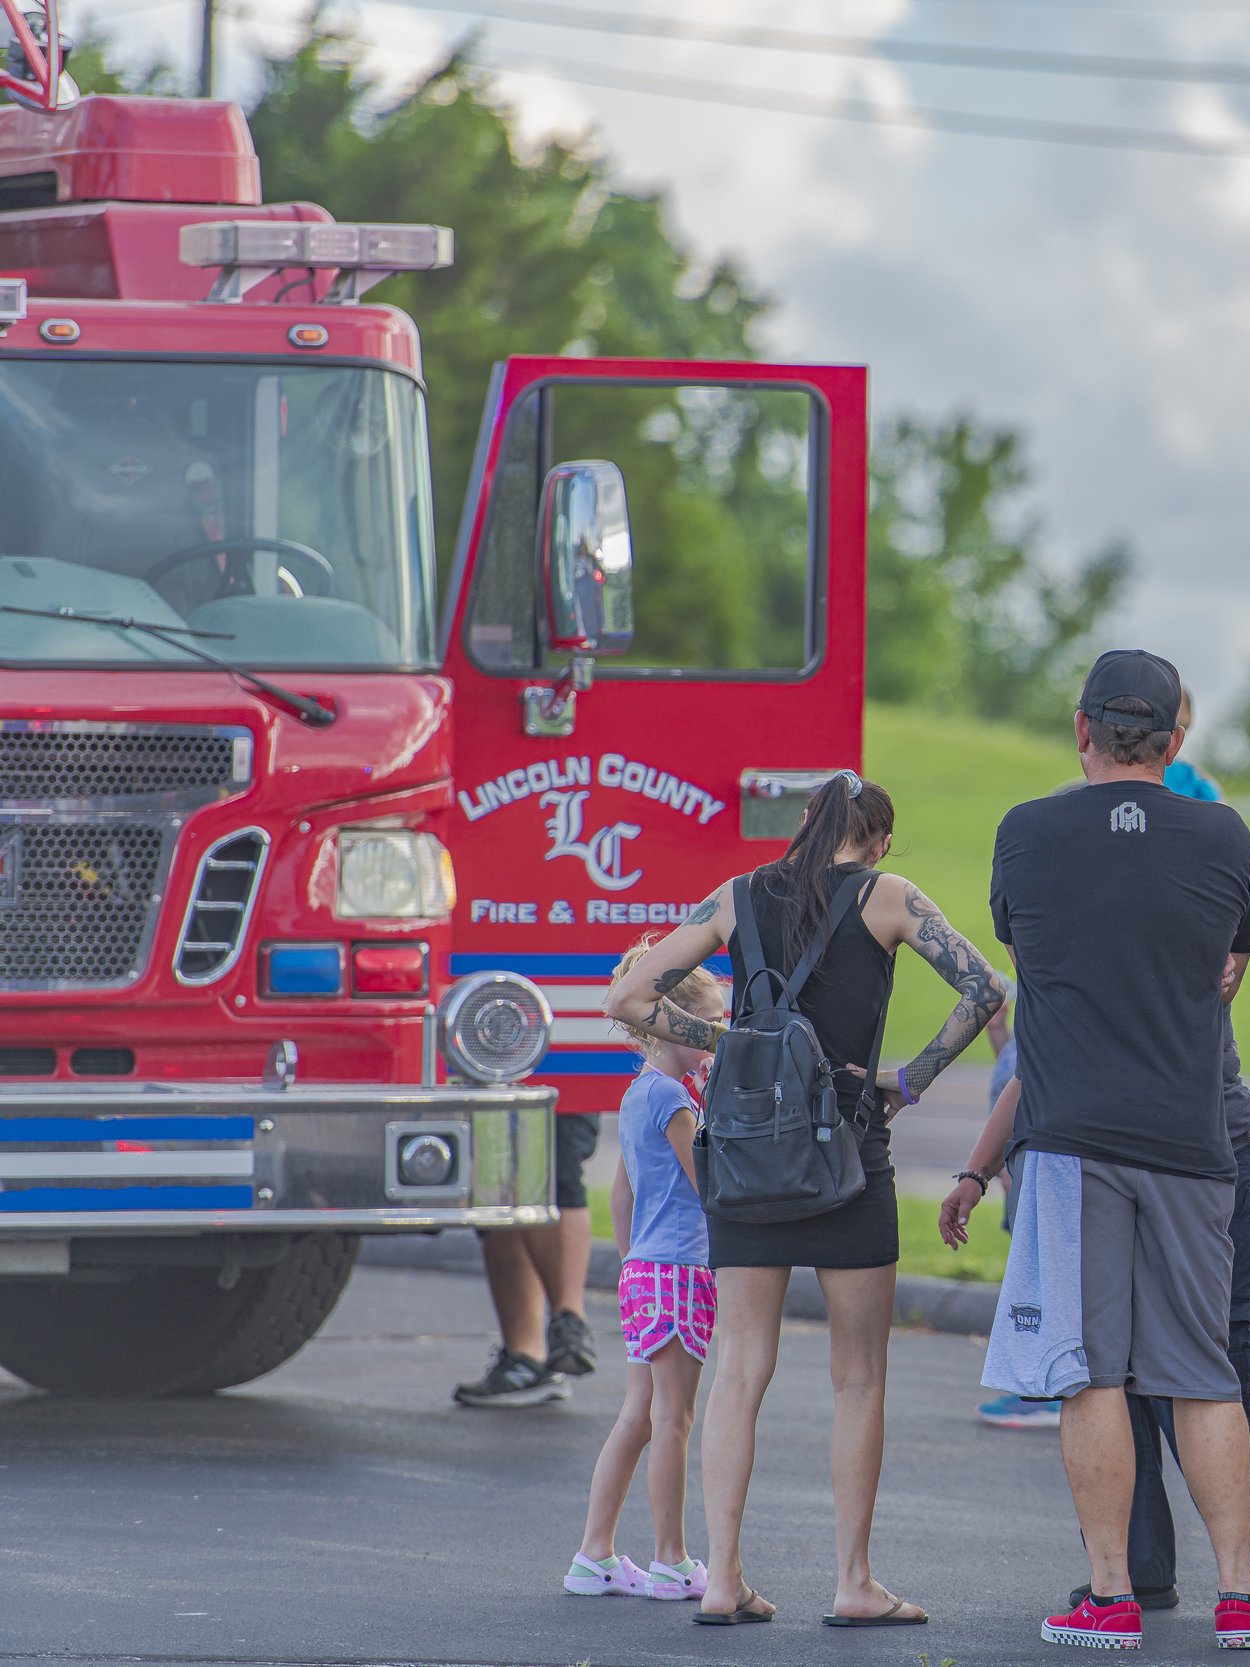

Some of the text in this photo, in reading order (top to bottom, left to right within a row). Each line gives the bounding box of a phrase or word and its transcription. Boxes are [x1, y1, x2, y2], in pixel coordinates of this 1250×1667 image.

[458, 753, 725, 824] LINCOLN COUNTY
[471, 900, 537, 924] FIRE
[548, 900, 575, 924] &
